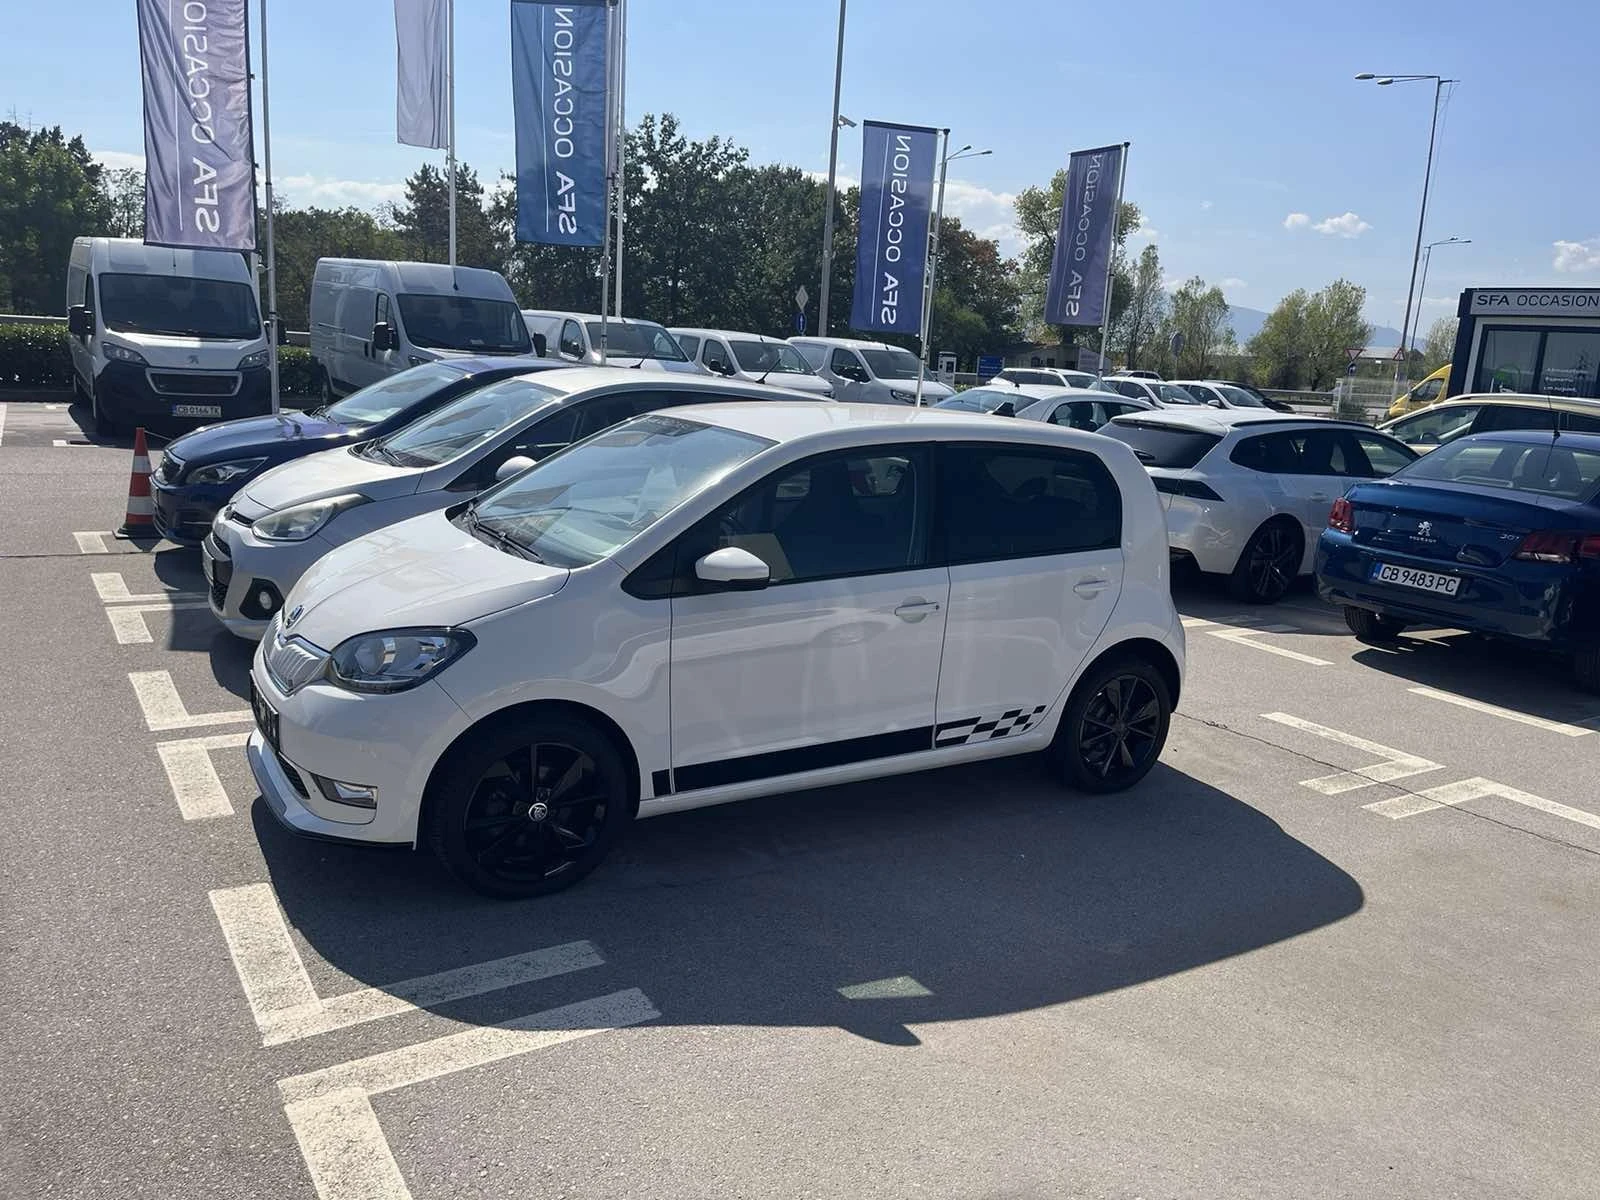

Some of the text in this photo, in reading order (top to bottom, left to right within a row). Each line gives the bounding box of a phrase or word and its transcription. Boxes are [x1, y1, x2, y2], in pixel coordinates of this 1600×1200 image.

[1477, 294, 1600, 307] SFA OCCASION
[1380, 566, 1457, 593] CB 9483 PC
